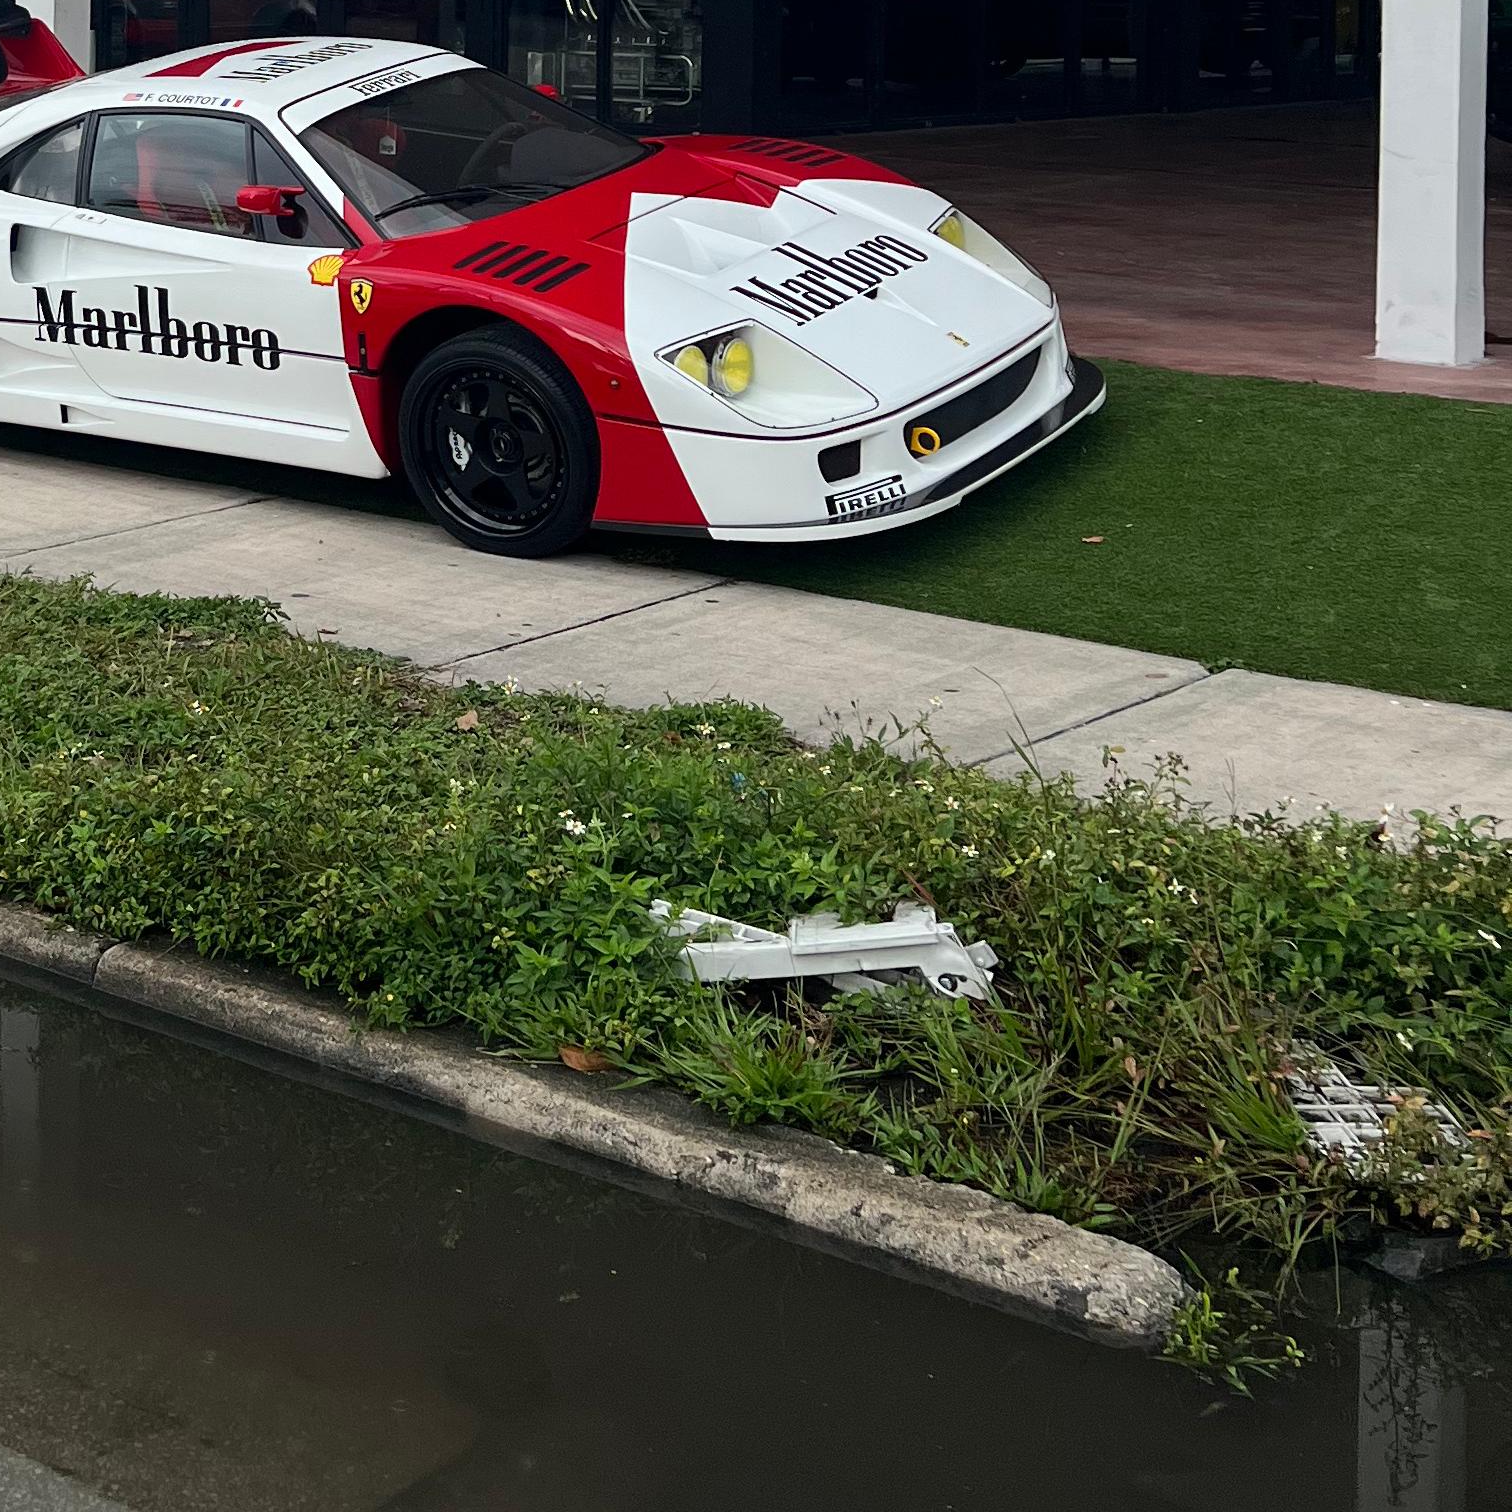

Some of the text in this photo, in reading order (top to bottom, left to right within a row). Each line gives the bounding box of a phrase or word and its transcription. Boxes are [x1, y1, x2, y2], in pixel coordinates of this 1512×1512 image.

[217, 42, 373, 84] Marlboro
[348, 68, 422, 96] Ferrari
[158, 94, 220, 106] COURTOT
[728, 235, 929, 327] Marlboro
[32, 284, 281, 371] Marlboro
[824, 474, 907, 516] PIRELLI
